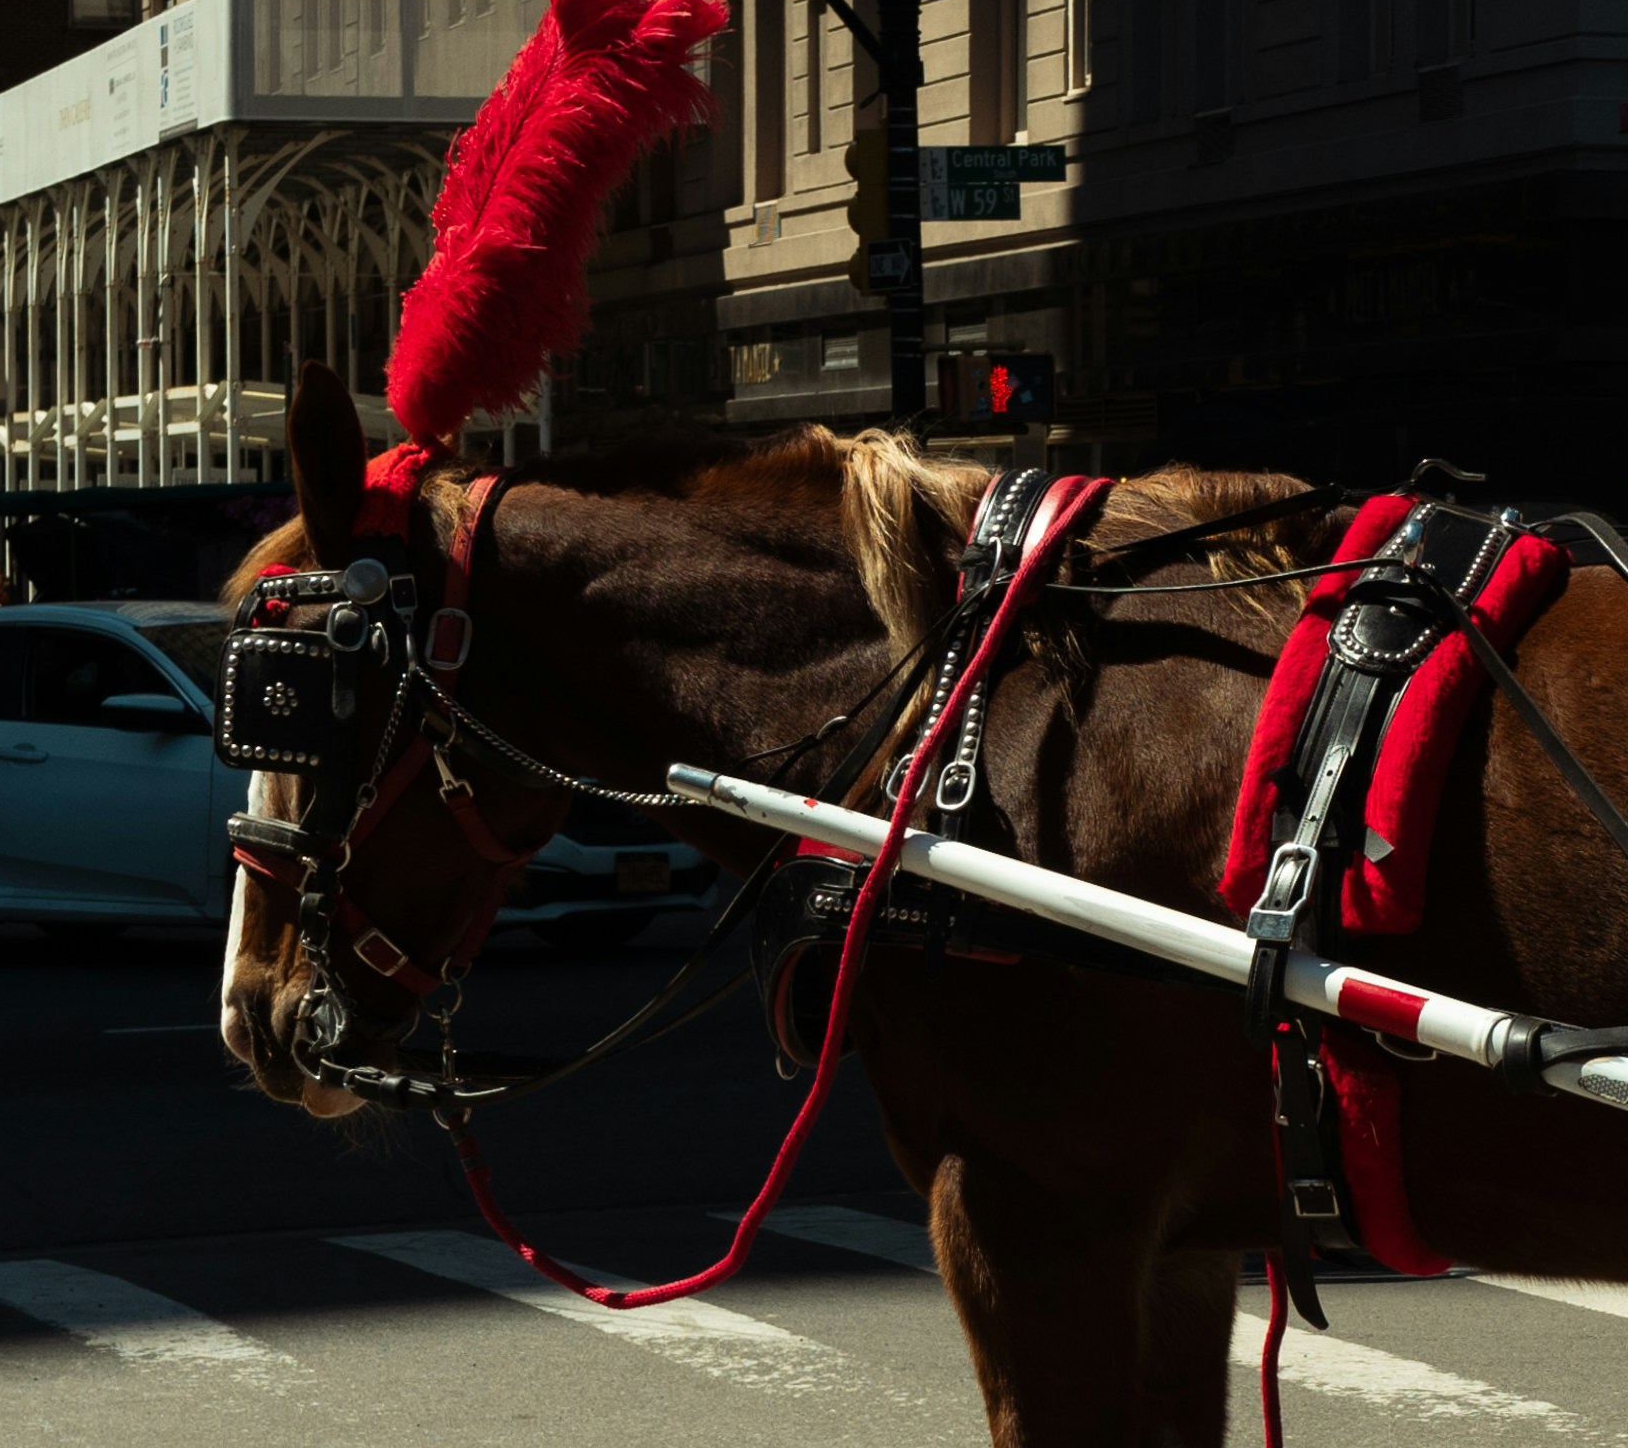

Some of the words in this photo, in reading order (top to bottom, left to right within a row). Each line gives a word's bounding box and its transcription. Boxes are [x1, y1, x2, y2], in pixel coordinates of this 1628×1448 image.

[951, 148, 1012, 168] Central
[1018, 148, 1058, 168] Park
[949, 189, 966, 216] W
[973, 188, 998, 216] 59
[1003, 188, 1015, 203] St
